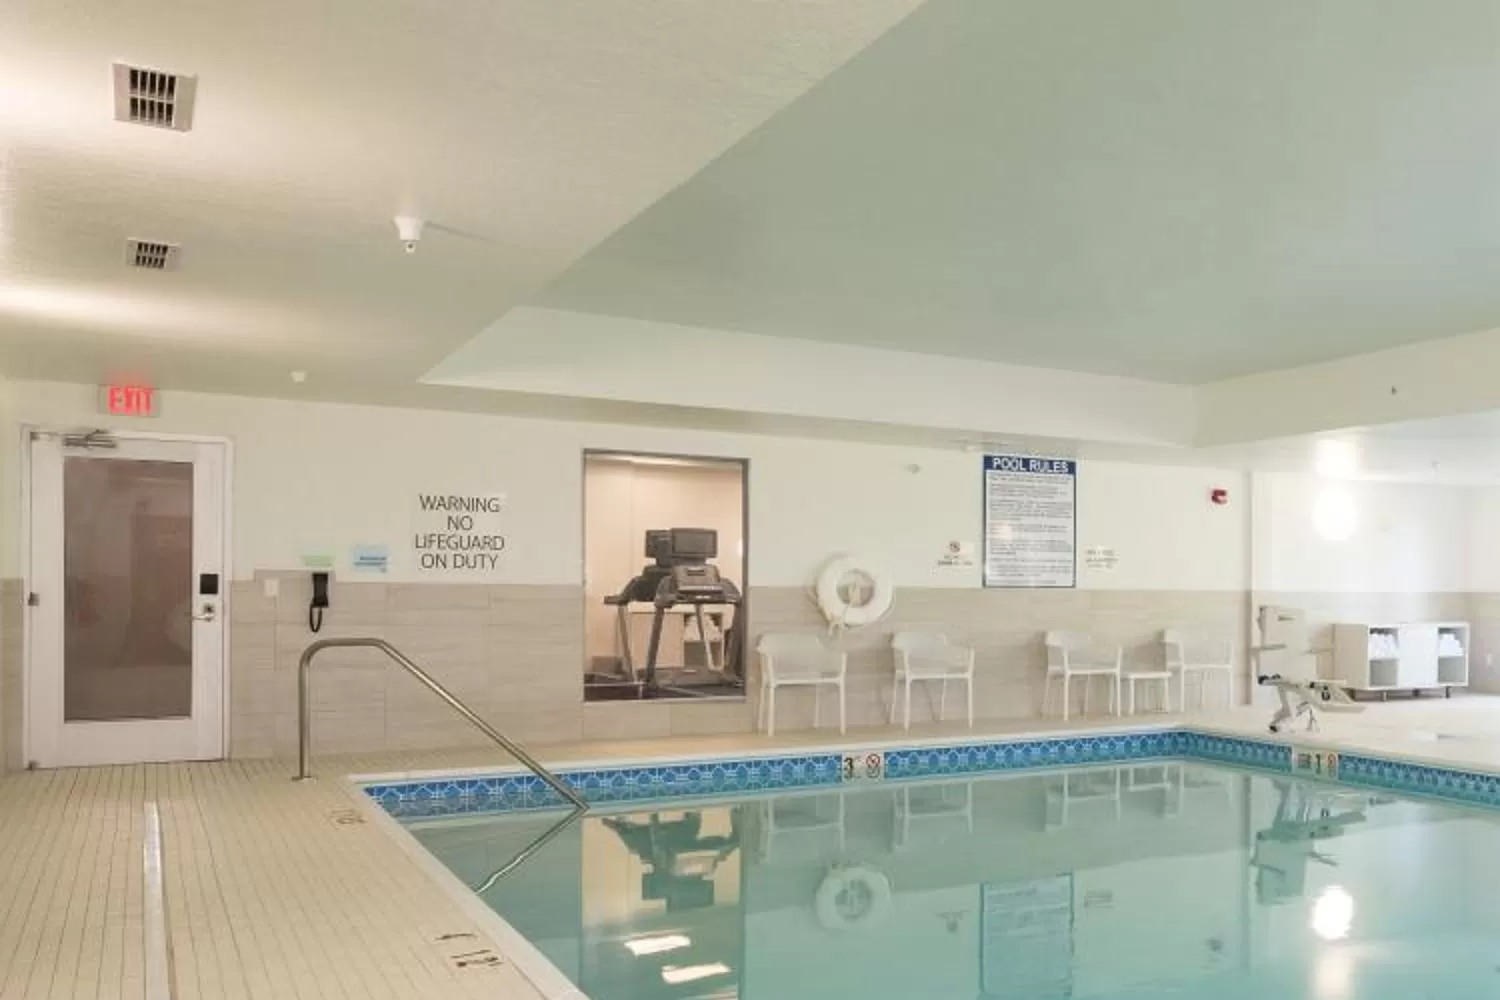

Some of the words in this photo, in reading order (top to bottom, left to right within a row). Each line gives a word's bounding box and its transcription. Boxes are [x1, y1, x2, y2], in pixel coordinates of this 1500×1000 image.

[109, 387, 153, 415] EXIT
[992, 457, 1026, 471] POOL
[1029, 460, 1069, 473] RULES
[419, 495, 500, 512] WARNING
[447, 515, 473, 531] NO
[415, 533, 505, 551] LIFEGUARD
[421, 553, 447, 569] ON
[453, 553, 499, 570] DUTY
